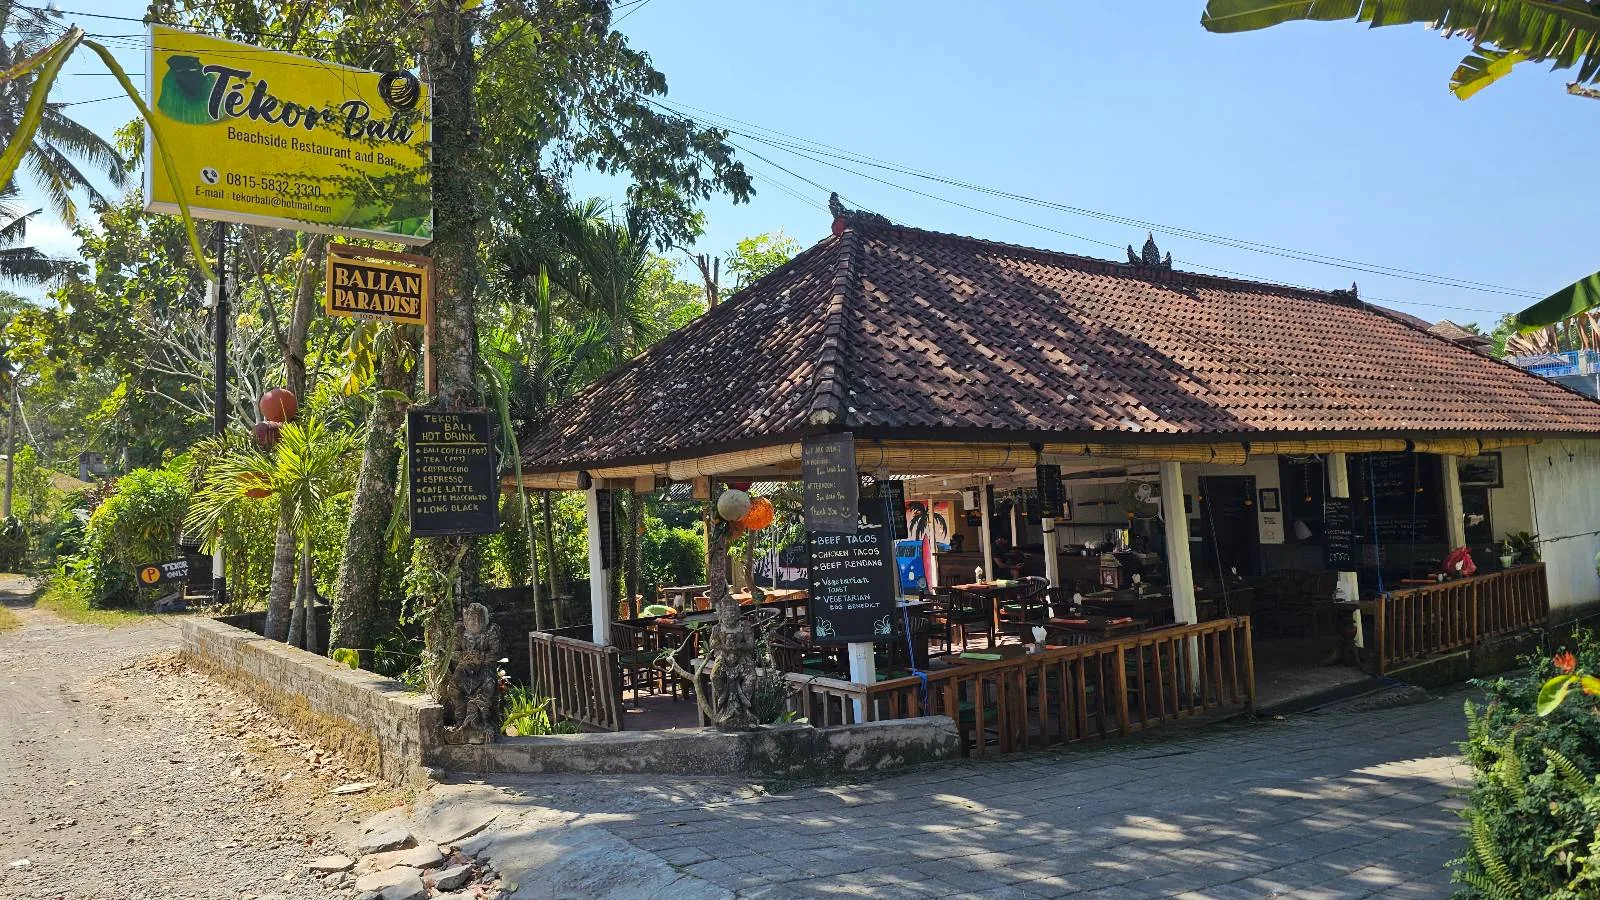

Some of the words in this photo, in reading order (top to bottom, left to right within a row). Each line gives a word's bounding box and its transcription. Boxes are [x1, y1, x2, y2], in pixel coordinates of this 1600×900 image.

[202, 64, 333, 131] Tékor
[339, 99, 415, 144] Bali
[227, 126, 288, 150] Beachside
[291, 137, 351, 160] Restaurant
[355, 151, 374, 163] and
[377, 153, 395, 166] Bar
[226, 172, 321, 198] 0815-5832-3330
[195, 185, 224, 199] E-mail
[232, 192, 332, 214] tekorbali@hotmail.com
[335, 267, 420, 295] BALIAN
[334, 288, 420, 315] PARADISE
[423, 415, 460, 423] TEKOR
[444, 423, 472, 432] BALI
[422, 431, 441, 441] HOT
[444, 432, 476, 441] DRINK
[423, 475, 464, 483] ESPRESSO
[445, 485, 473, 493] LATTE
[422, 495, 447, 503] LATTE
[423, 504, 448, 514] LONG
[451, 504, 479, 512] BLACK
[817, 535, 841, 545] BEEF
[845, 534, 877, 544] TACOS
[817, 549, 849, 559] CHICKEN
[852, 547, 880, 556] TACOS
[161, 560, 189, 572] TEKOR
[819, 561, 842, 571] BEEF
[844, 559, 883, 569] RENDANG
[147, 568, 155, 582] P
[166, 568, 189, 579] ONLY
[827, 586, 848, 594] TOAST
[823, 594, 871, 604] VEGETARIAN
